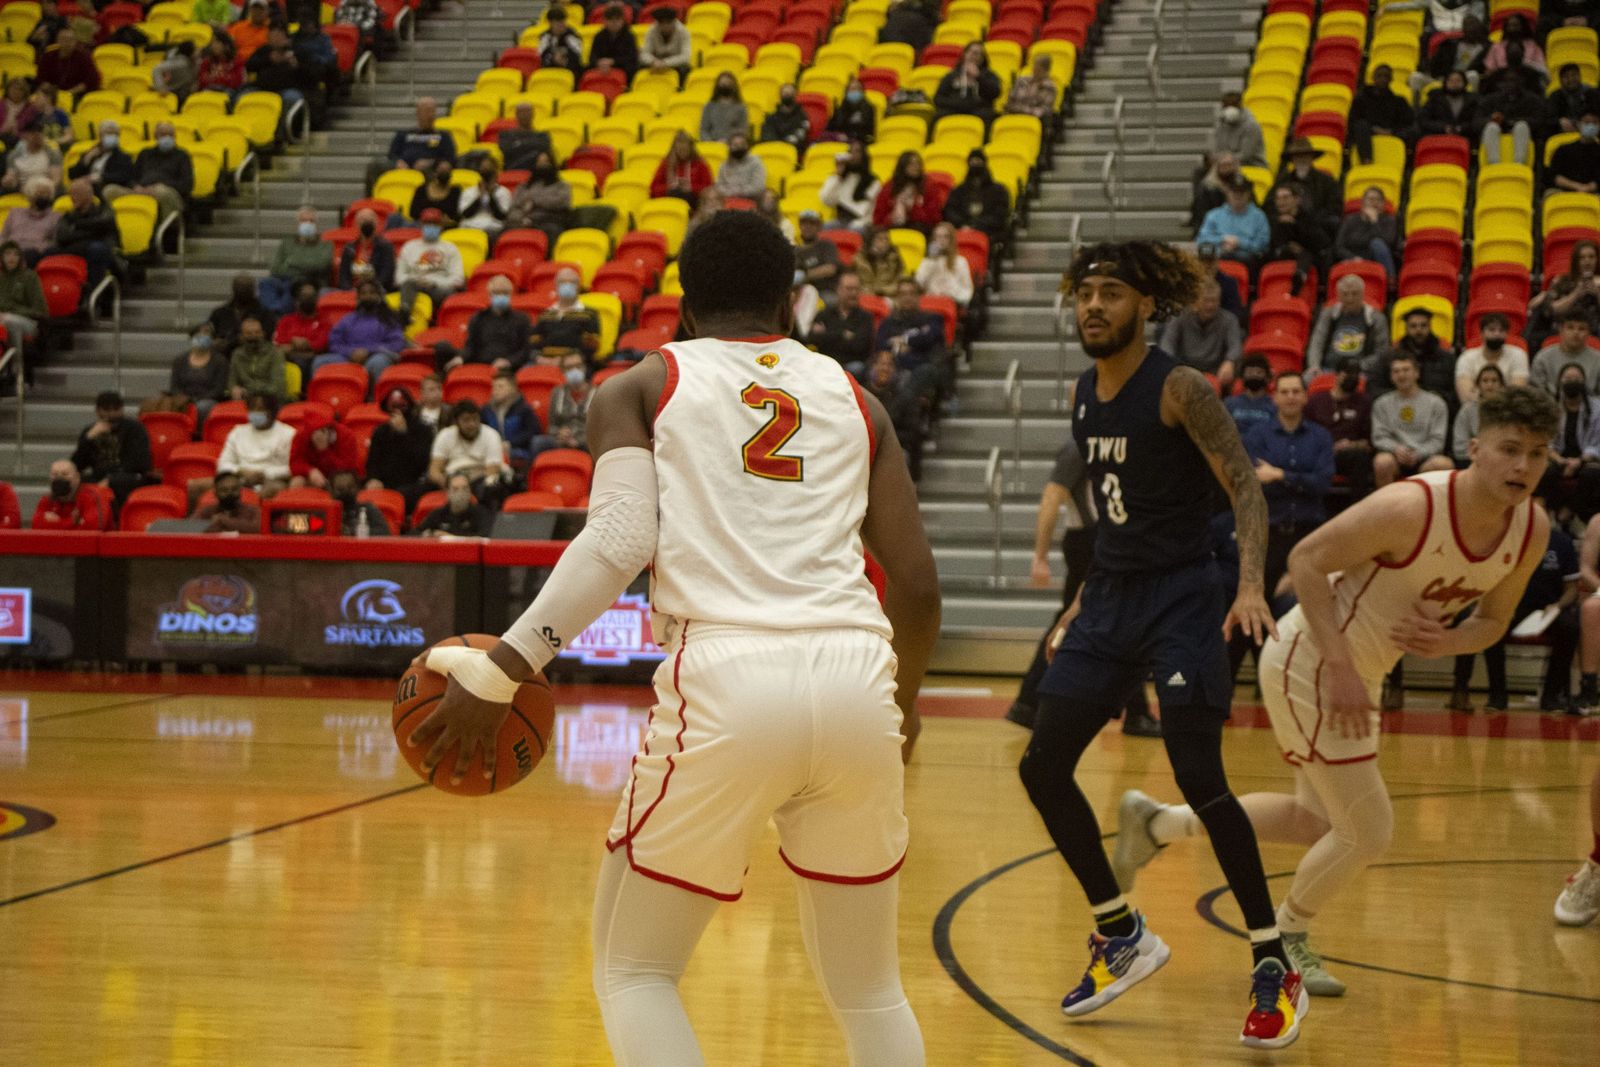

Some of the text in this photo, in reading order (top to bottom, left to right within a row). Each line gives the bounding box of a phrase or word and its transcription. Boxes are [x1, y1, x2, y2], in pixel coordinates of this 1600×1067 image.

[741, 381, 804, 482] 2
[1086, 436, 1128, 464] TWU
[159, 611, 257, 635] DINOS
[324, 625, 425, 648] SPARTANS
